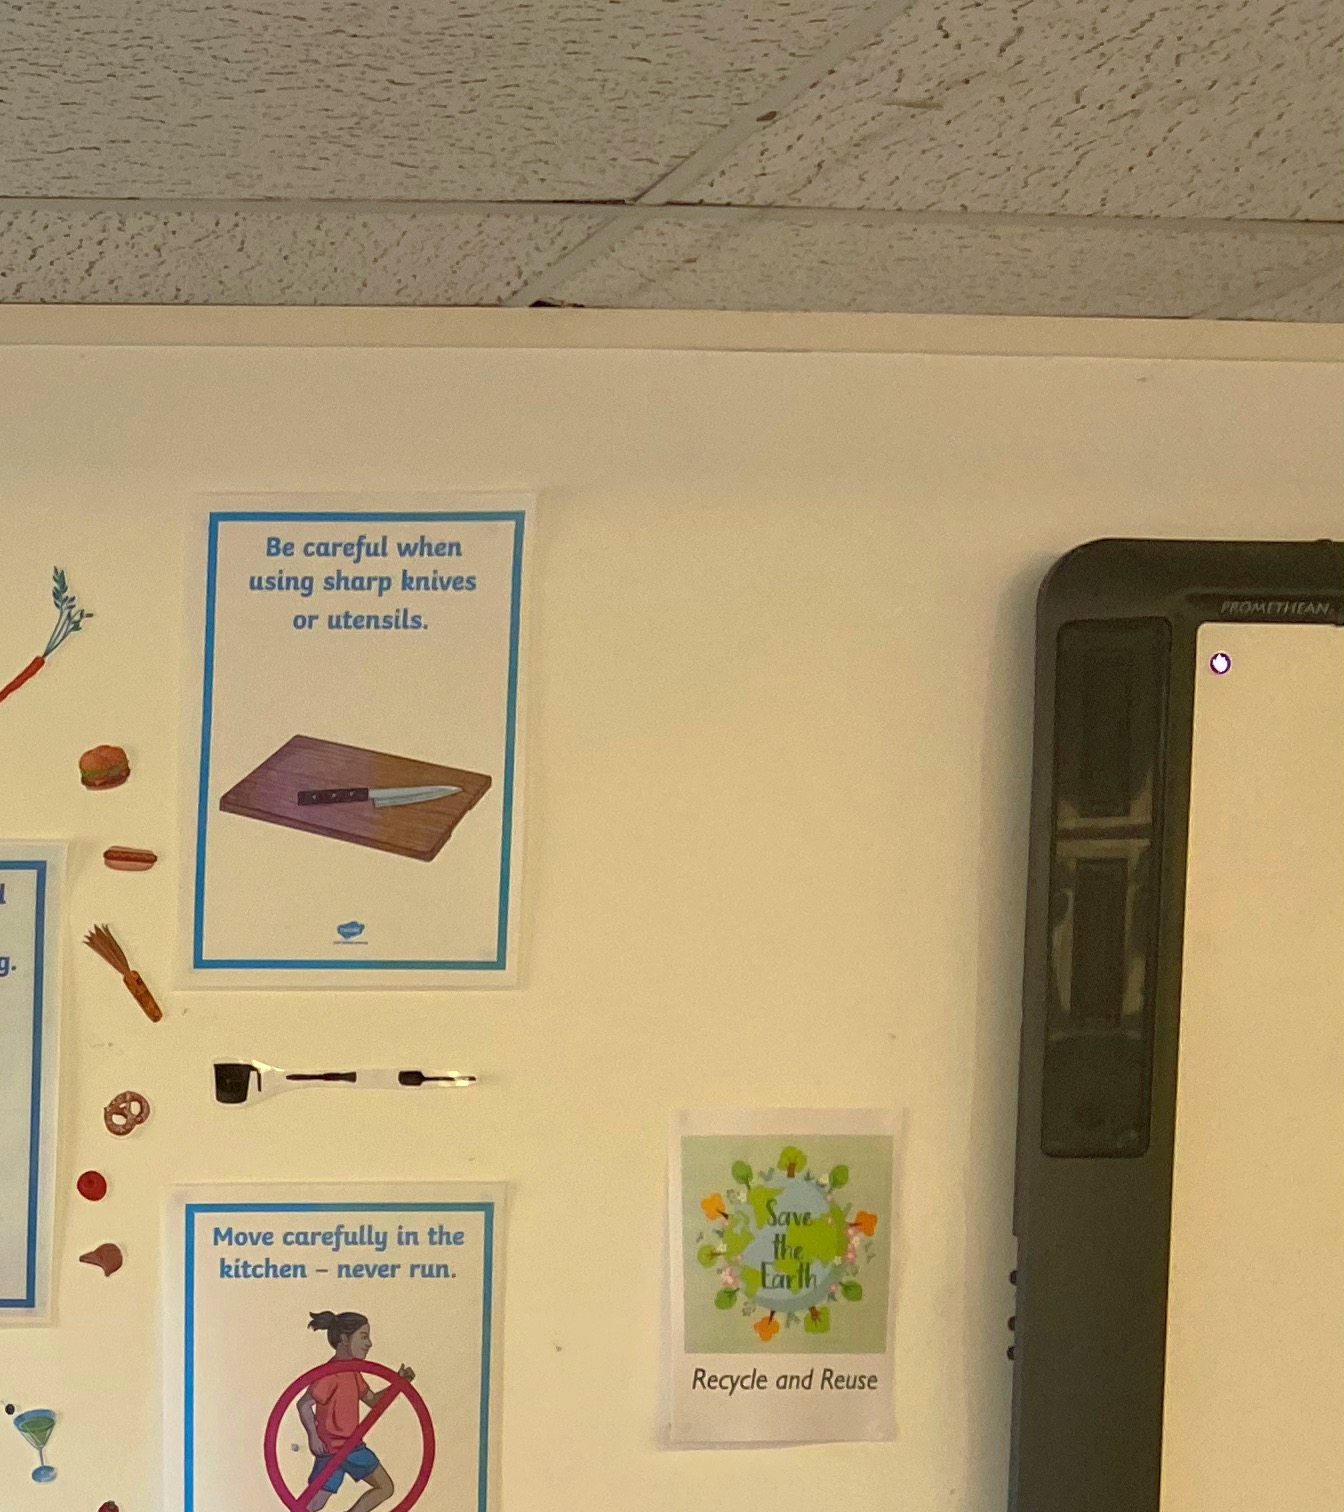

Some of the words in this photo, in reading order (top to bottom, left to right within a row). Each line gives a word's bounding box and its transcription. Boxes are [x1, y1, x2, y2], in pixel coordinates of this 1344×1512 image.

[266, 537, 295, 557] Be
[303, 534, 388, 564] careful
[397, 536, 462, 557] when
[249, 569, 314, 597] using
[323, 569, 392, 597] sharp
[401, 569, 477, 591] knives
[293, 613, 319, 630] or
[327, 608, 428, 630] utensils.
[1221, 600, 1330, 616] PROMETHEAN
[766, 1199, 811, 1227] Save
[213, 1227, 274, 1246] Move
[282, 1224, 388, 1252] carefully
[397, 1225, 419, 1246] in
[428, 1225, 464, 1246] the
[773, 1233, 803, 1260] the
[220, 1258, 307, 1279] kitchen
[338, 1263, 401, 1279] never
[410, 1263, 457, 1279] run.
[761, 1262, 817, 1290] Earth
[692, 1368, 768, 1396] Recycle
[776, 1368, 813, 1390] and
[820, 1369, 878, 1390] Reuse
